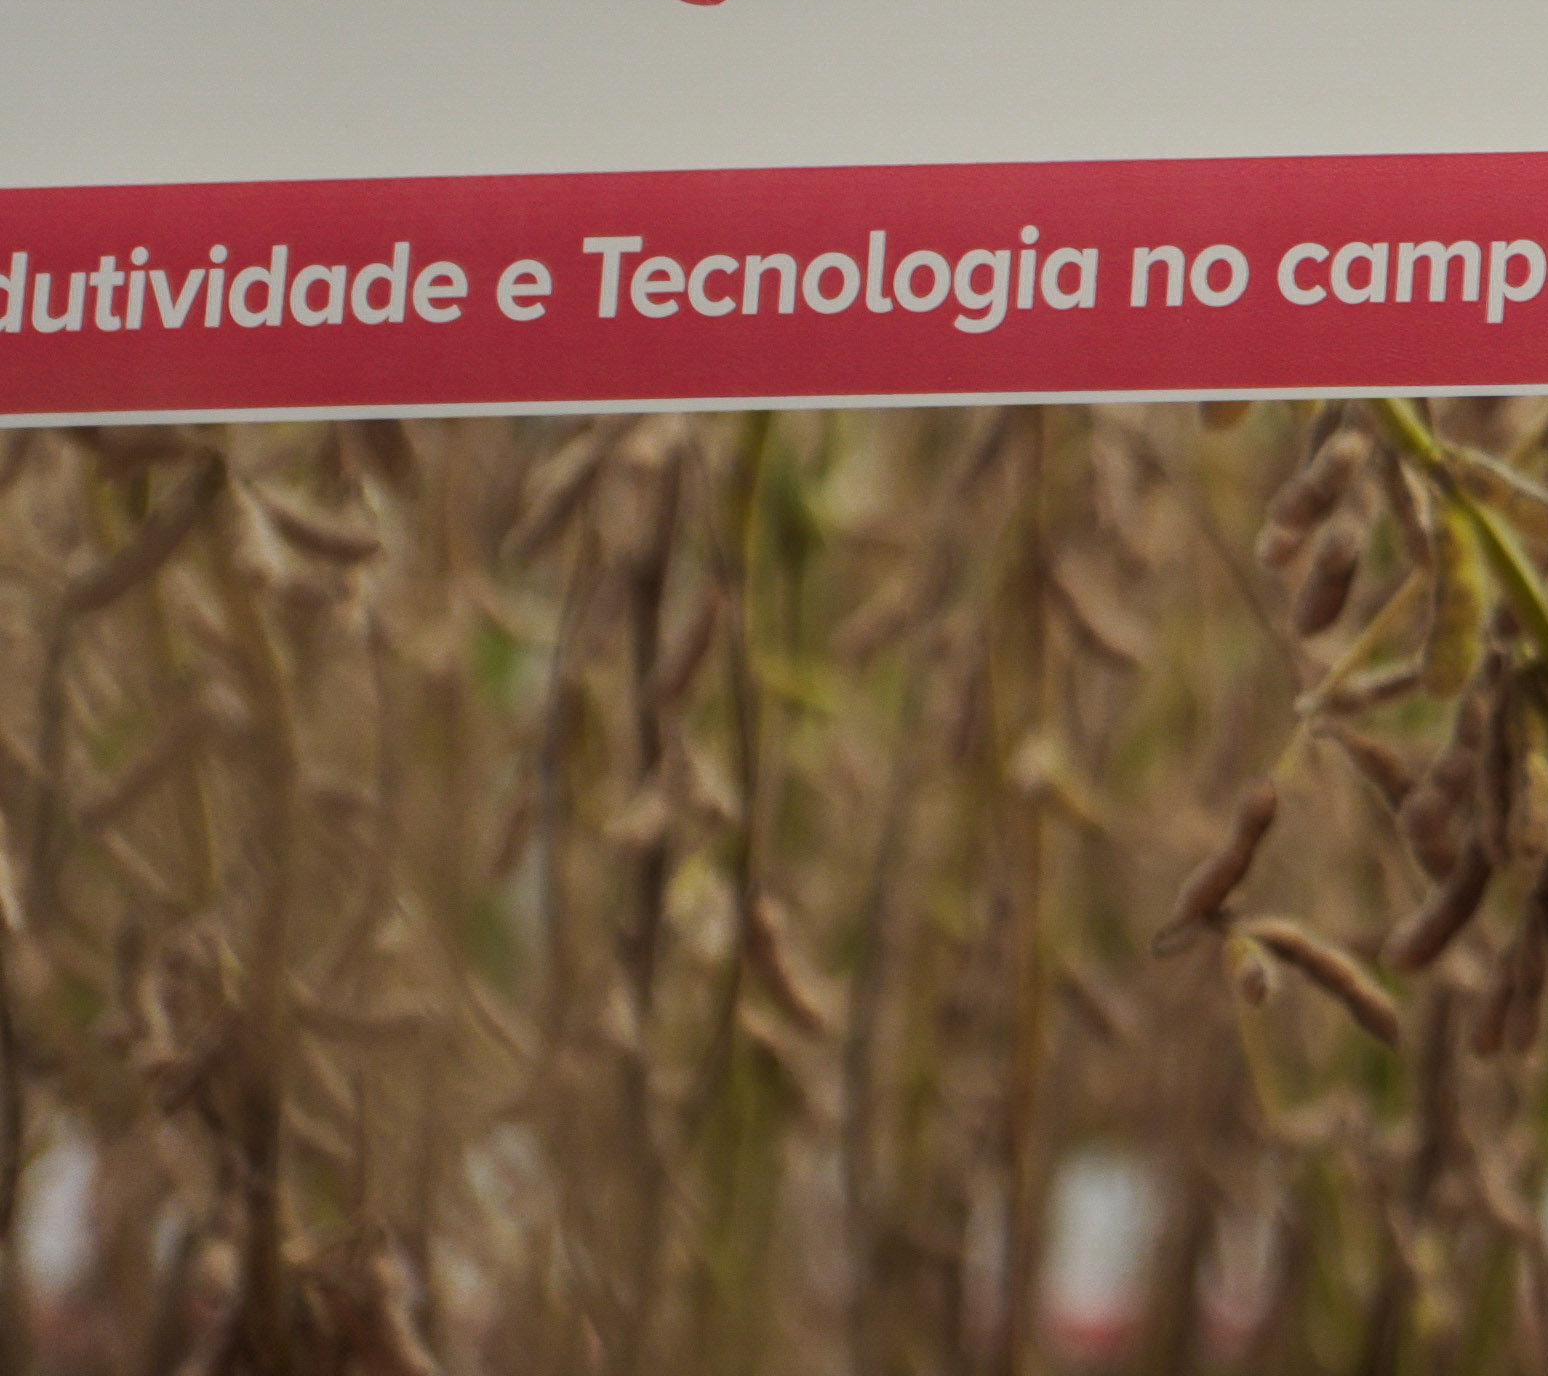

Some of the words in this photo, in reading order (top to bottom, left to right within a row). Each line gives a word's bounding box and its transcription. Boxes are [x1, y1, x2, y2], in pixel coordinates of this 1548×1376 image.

[496, 258, 553, 322] e
[582, 224, 1100, 334] Tecnologia
[1130, 244, 1250, 307] no
